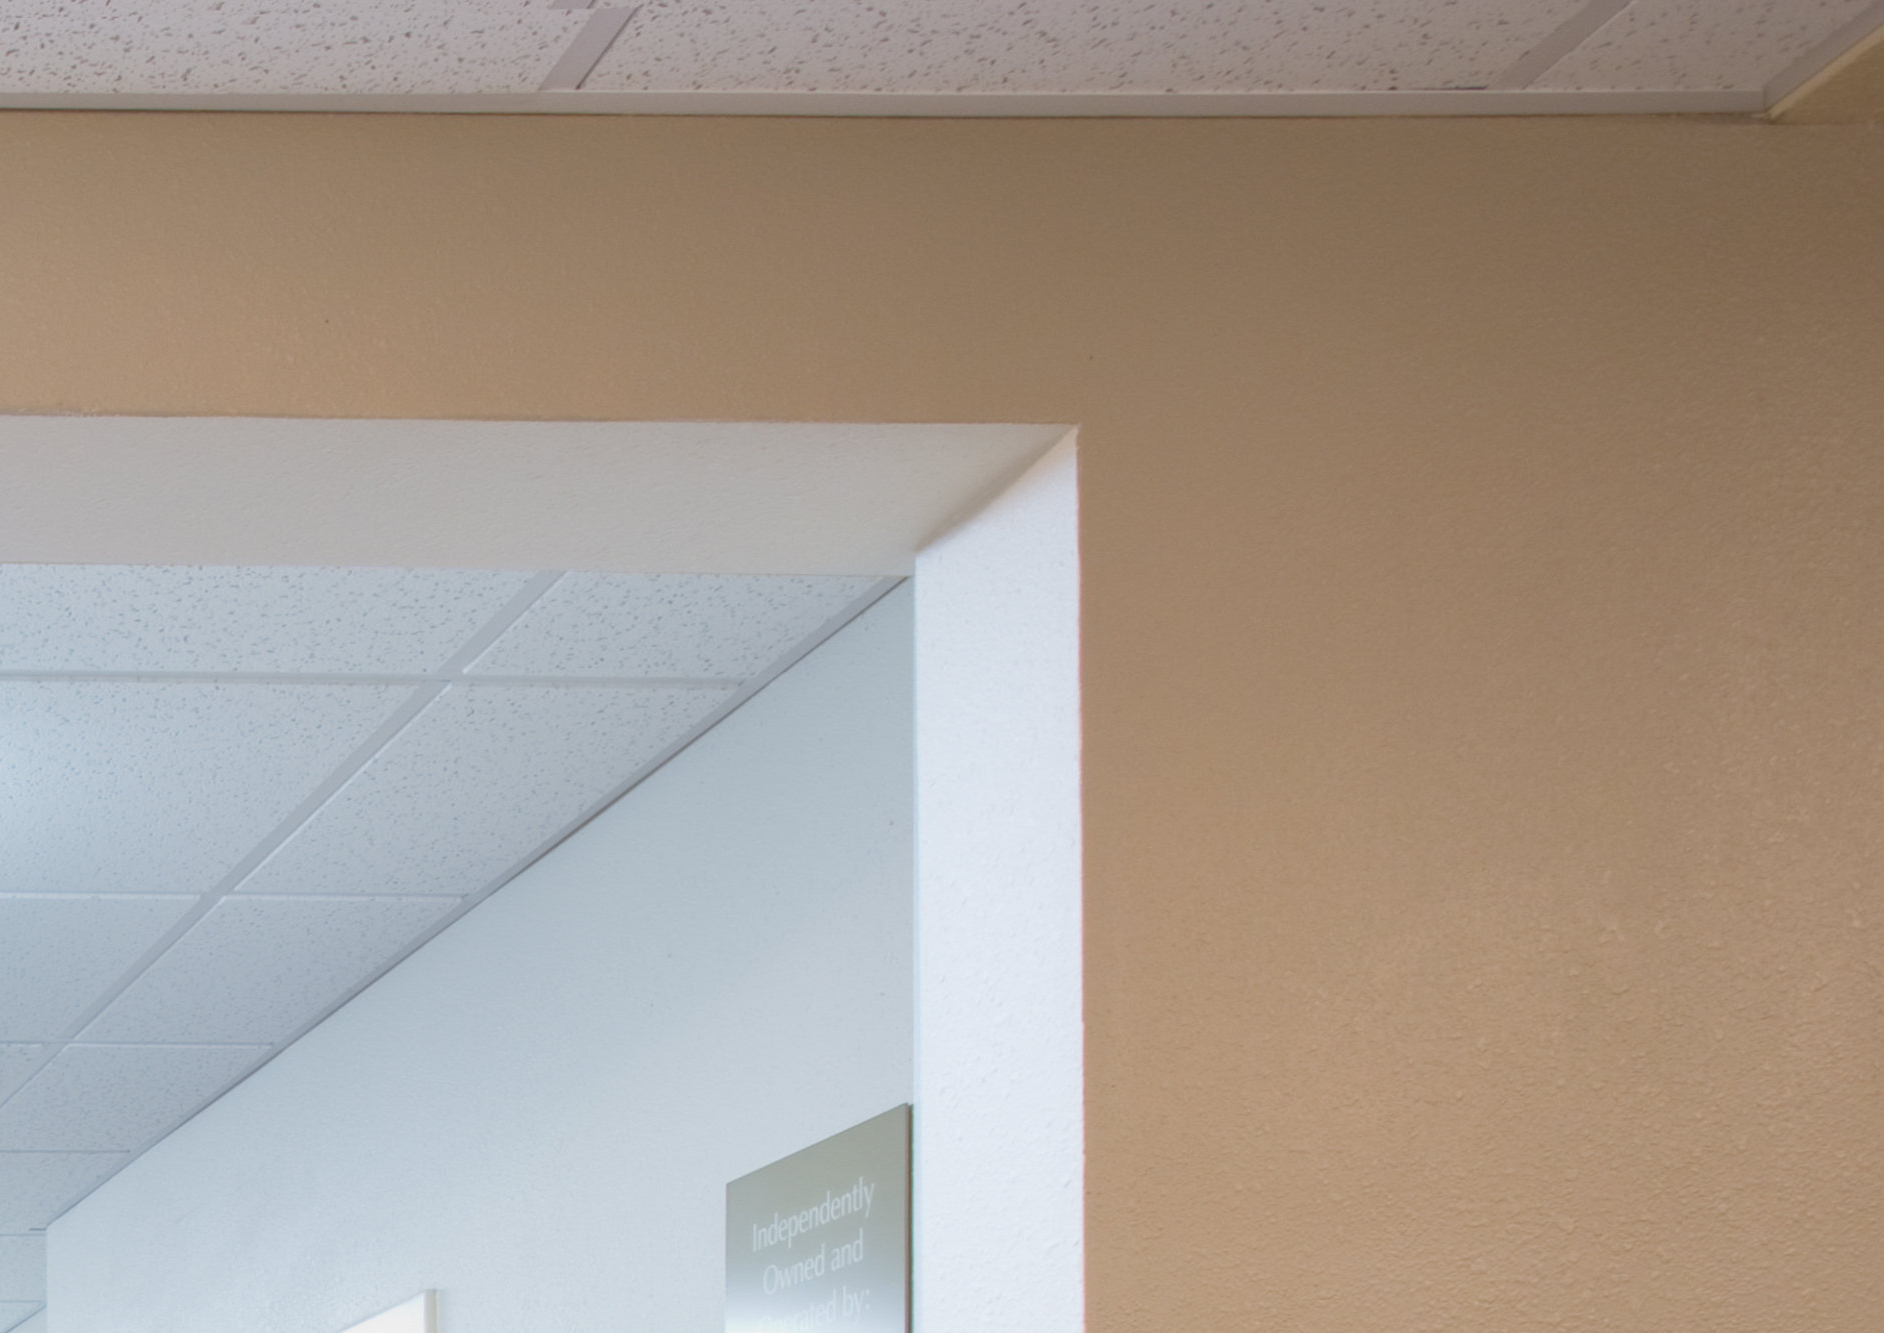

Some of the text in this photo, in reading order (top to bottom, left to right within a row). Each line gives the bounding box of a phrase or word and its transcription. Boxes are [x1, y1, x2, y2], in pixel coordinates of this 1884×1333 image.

[752, 1176, 875, 1251] Independently
[763, 1227, 863, 1295] Owned and
[843, 1285, 871, 1329] by:
